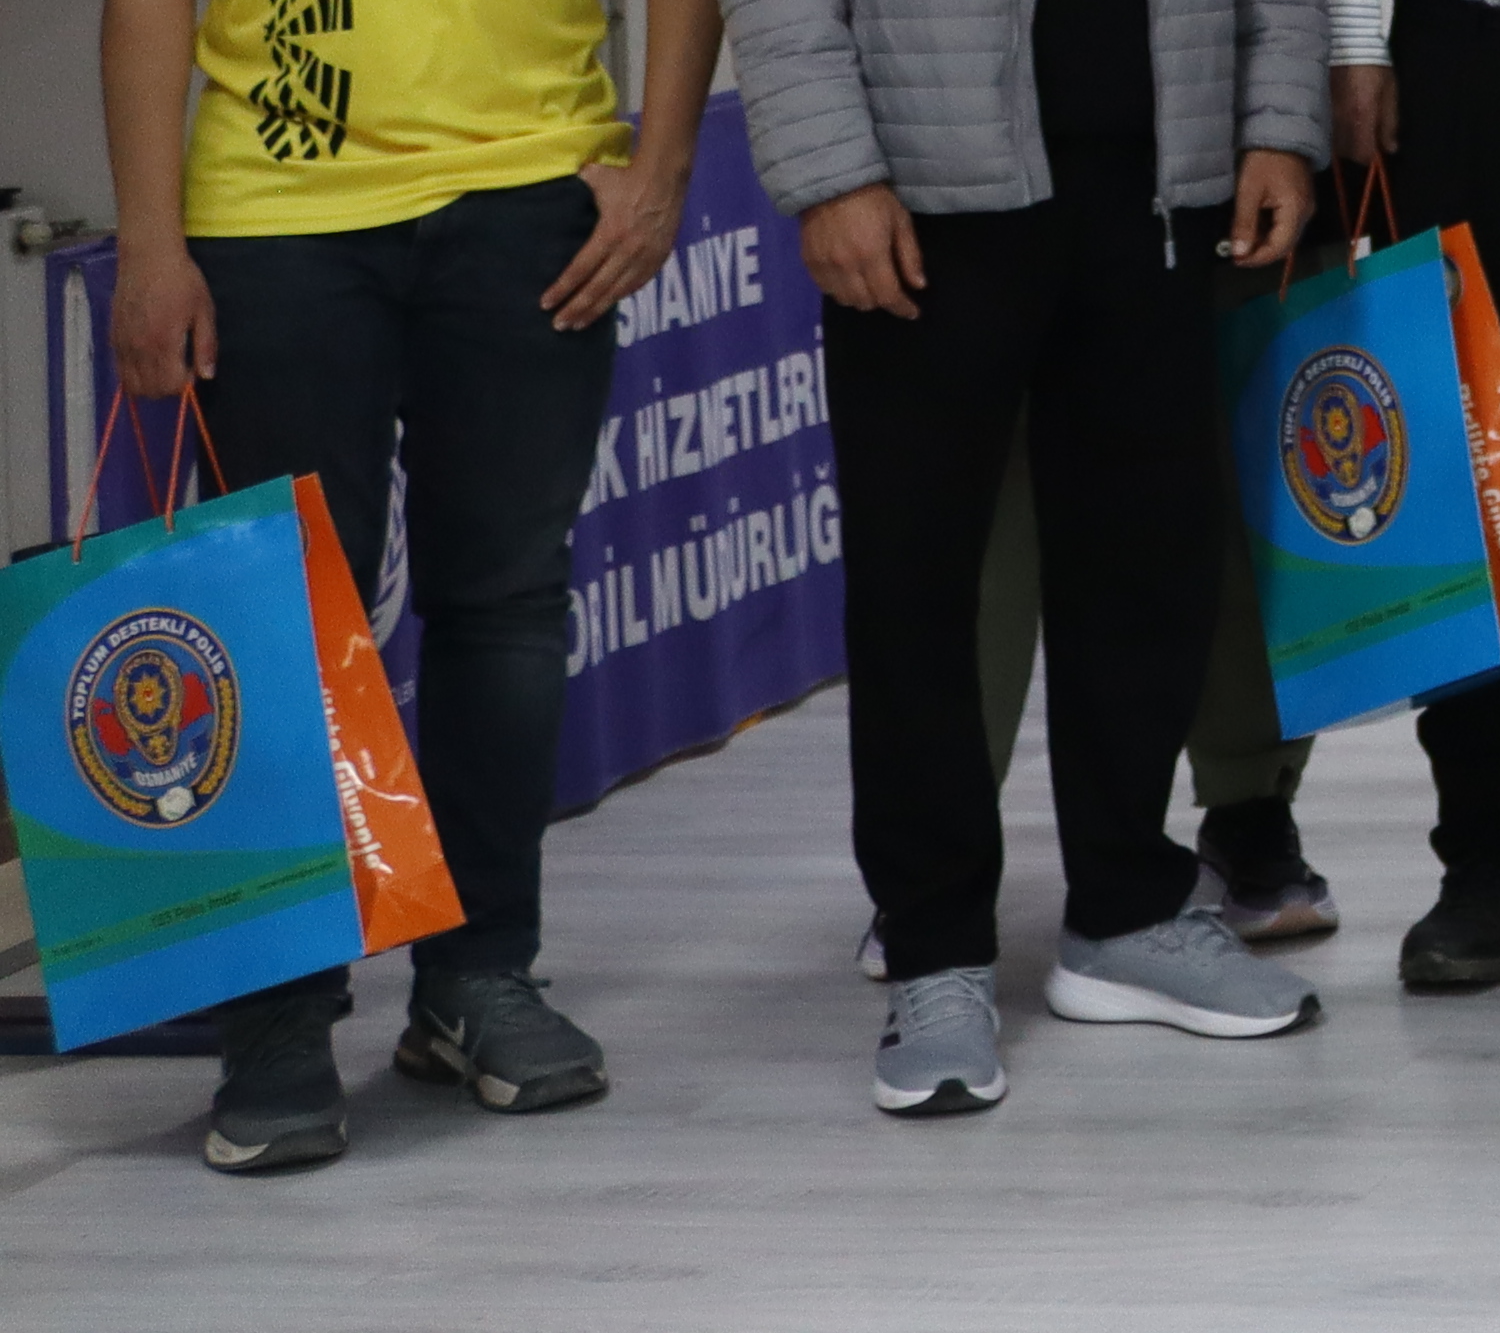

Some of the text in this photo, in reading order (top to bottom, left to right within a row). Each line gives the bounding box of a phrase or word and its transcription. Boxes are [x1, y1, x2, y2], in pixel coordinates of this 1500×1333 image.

[614, 214, 764, 348] SMANİYE
[651, 461, 843, 635] MÜDÜRLÜĞ
[72, 616, 227, 720] TOPLUM DESTEKLİ POLİS
